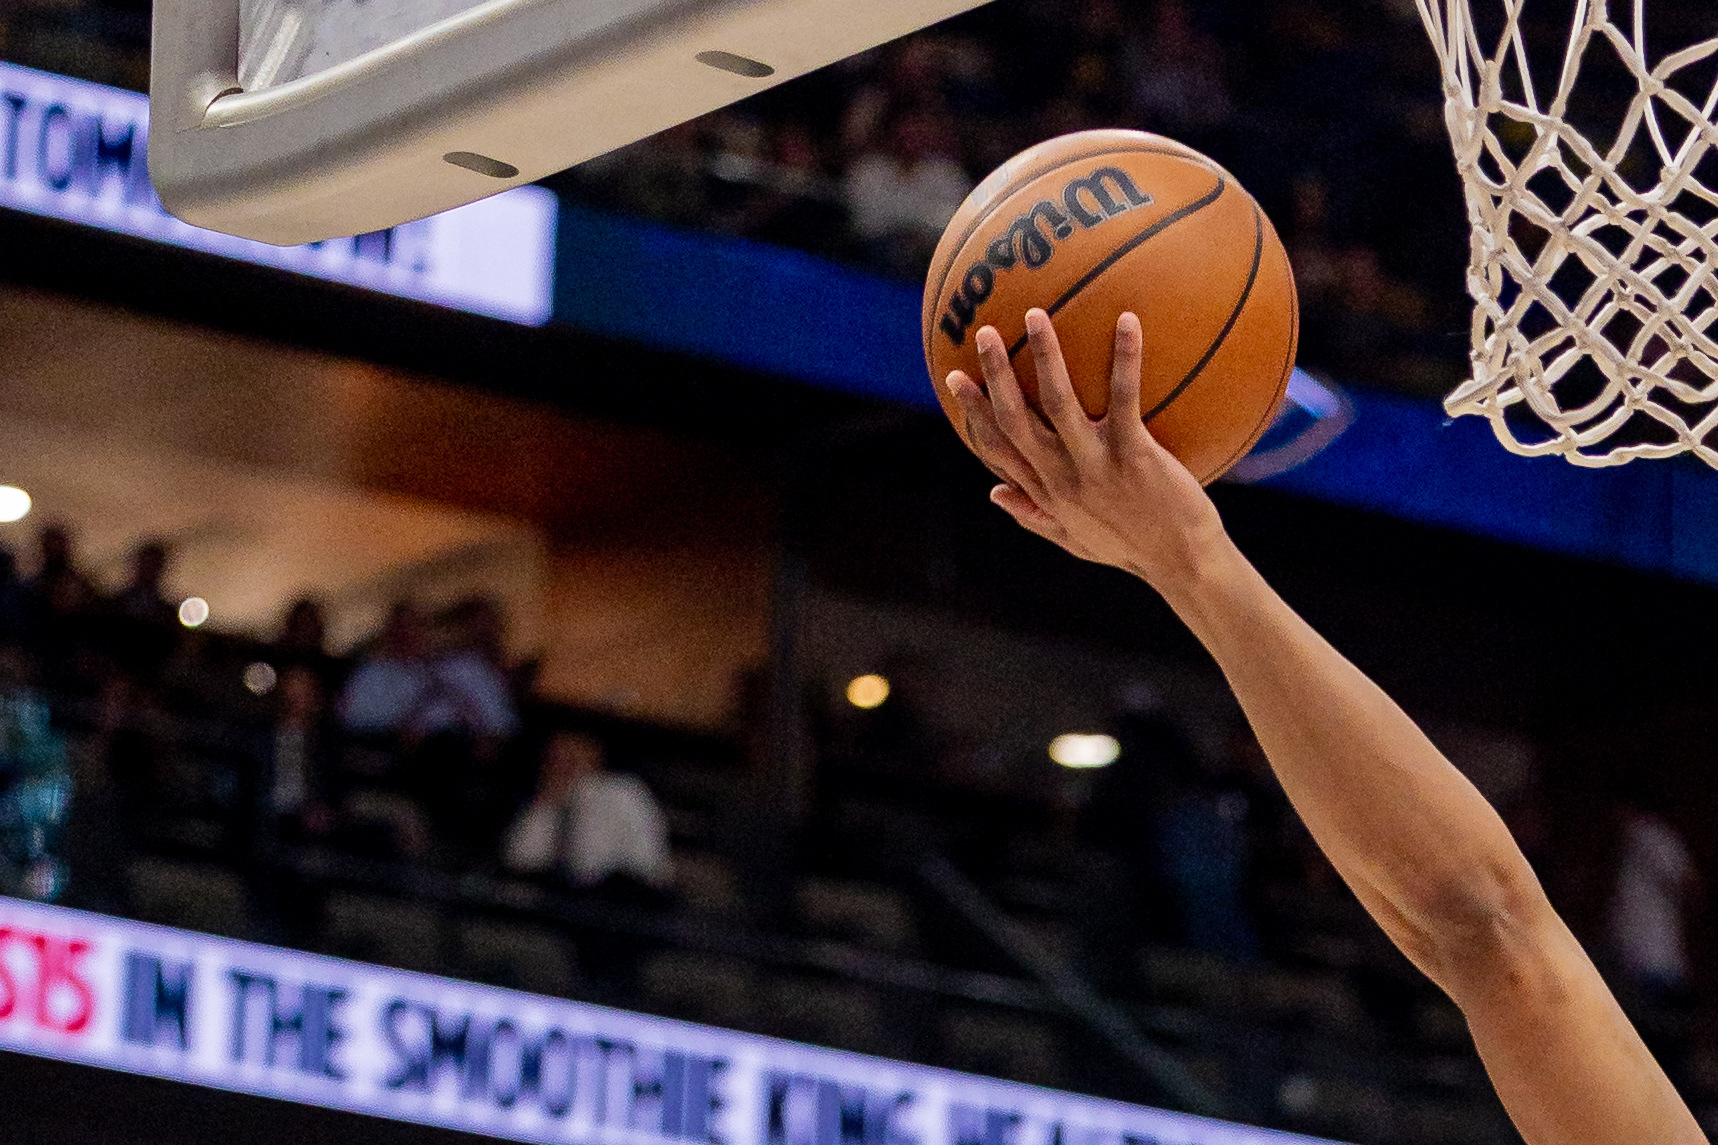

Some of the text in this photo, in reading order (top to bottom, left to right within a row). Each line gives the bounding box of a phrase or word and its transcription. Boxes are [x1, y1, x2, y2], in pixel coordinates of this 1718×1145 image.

[939, 166, 1154, 346] Wilson
[121, 946, 195, 1053] IN
[228, 968, 349, 1082] THE
